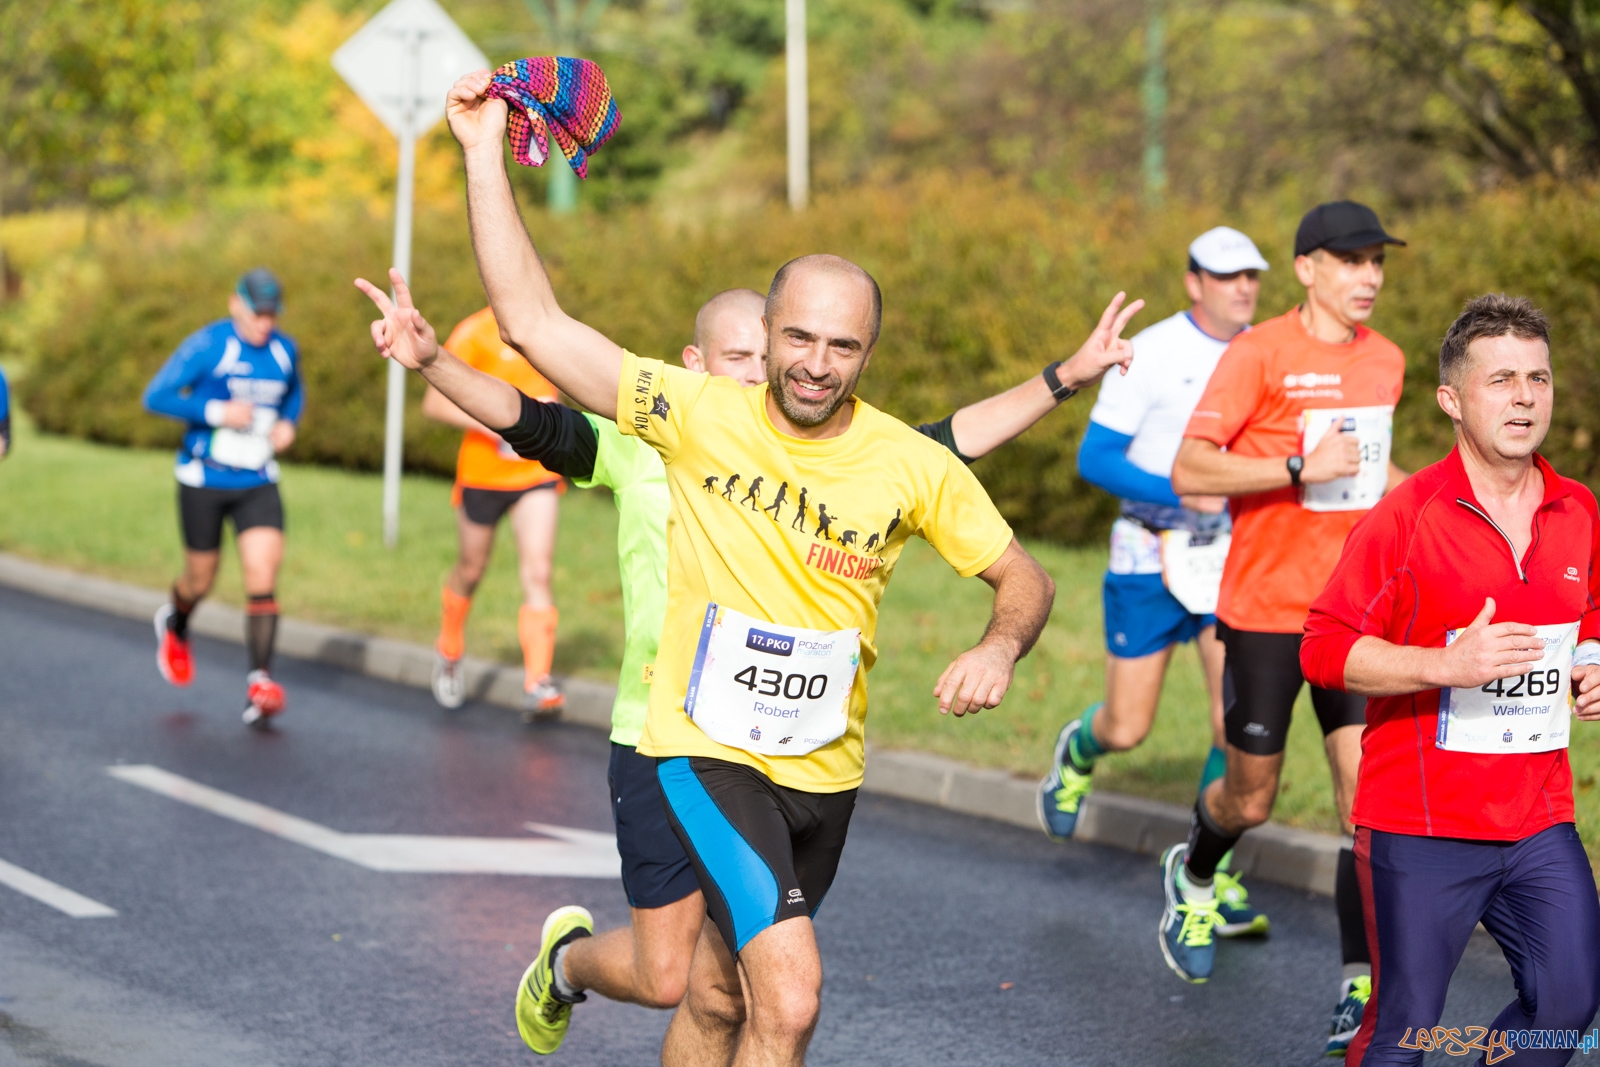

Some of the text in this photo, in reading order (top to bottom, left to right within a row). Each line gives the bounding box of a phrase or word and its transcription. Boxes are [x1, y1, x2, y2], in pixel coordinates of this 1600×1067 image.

[635, 369, 653, 431] MEN'S 10K
[751, 634, 791, 651] 17. PKO
[796, 648, 832, 657] maraton
[734, 665, 828, 700] 4300
[1481, 668, 1560, 698] 4269
[753, 701, 800, 718] Robert
[1493, 704, 1551, 716] Waldemar
